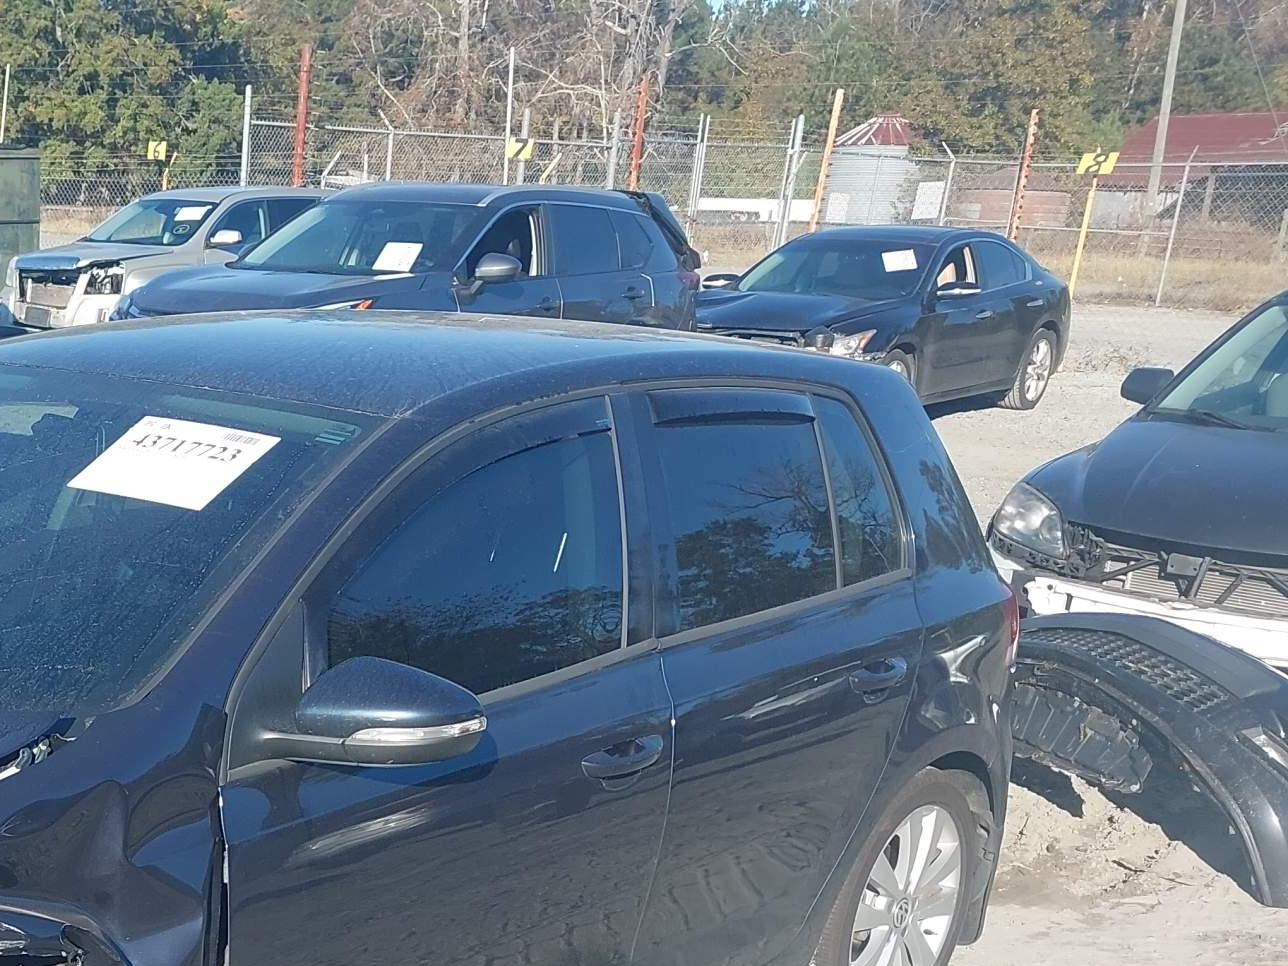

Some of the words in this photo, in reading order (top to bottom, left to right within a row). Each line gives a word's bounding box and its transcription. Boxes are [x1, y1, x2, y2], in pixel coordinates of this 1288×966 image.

[153, 142, 162, 159] 6
[512, 137, 529, 159] 7
[1084, 152, 1110, 174] 8
[133, 433, 242, 462] 43717723
